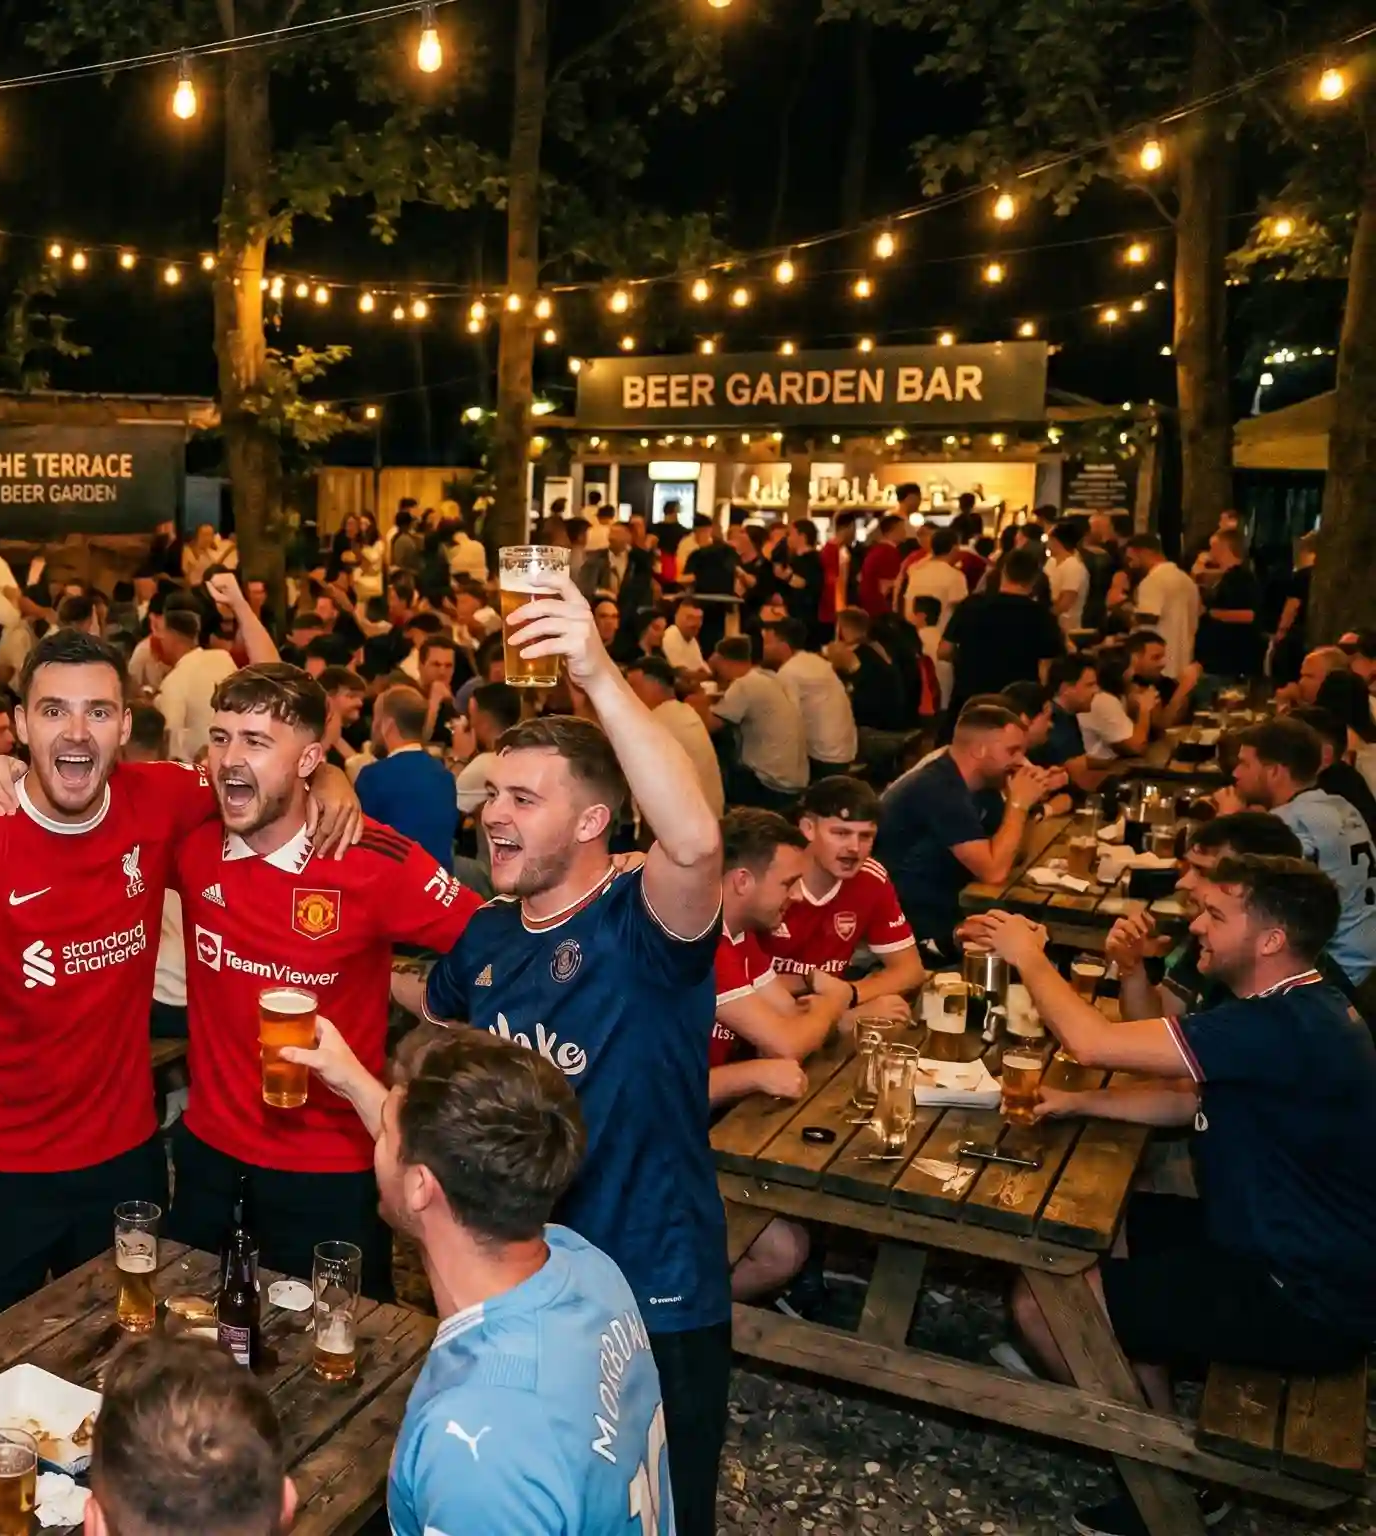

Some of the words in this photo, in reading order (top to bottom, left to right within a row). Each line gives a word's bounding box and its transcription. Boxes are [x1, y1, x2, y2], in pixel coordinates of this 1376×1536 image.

[623, 374, 715, 409] BEER
[725, 369, 885, 406] GARDEN
[897, 365, 983, 402] BAR
[32, 453, 133, 477] TERRACE
[0, 484, 44, 503] BEER
[49, 484, 117, 502] GARDEN
[62, 920, 144, 960] standard
[64, 935, 146, 975] chartered
[223, 948, 339, 986] TeamViewer
